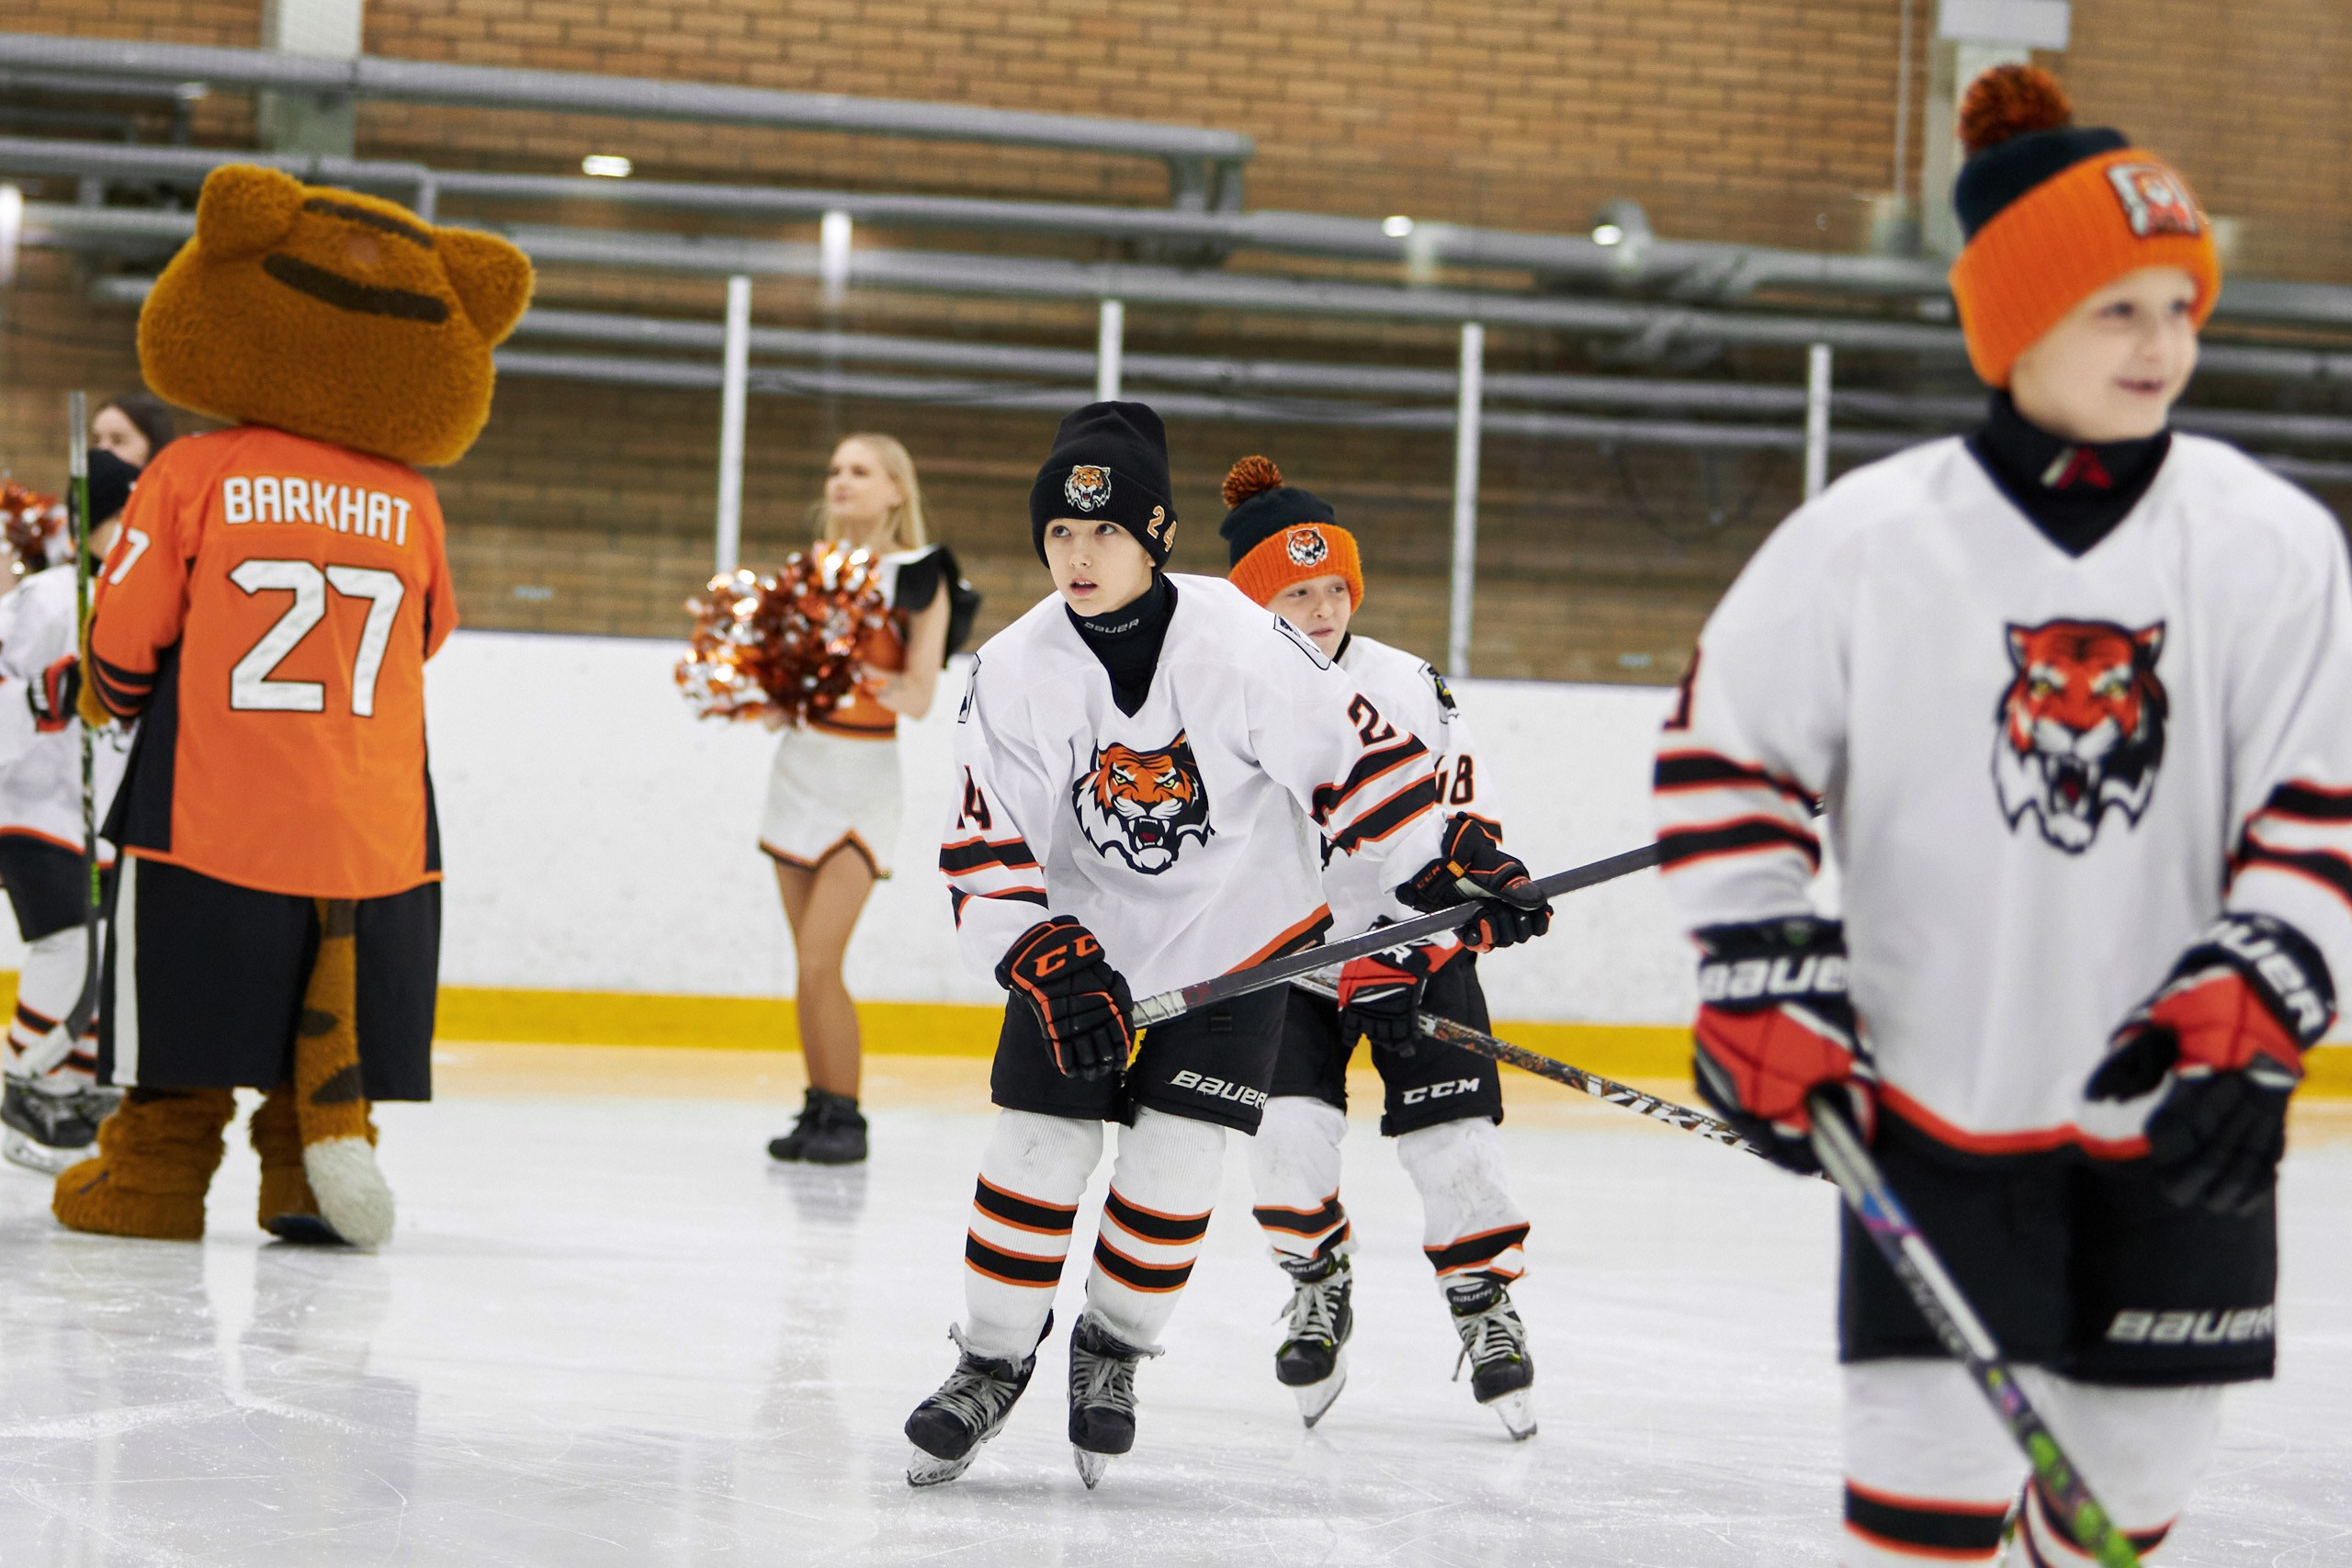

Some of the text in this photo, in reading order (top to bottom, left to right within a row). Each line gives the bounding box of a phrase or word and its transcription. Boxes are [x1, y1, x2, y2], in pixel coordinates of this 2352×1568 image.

[224, 476, 412, 546] BARKHAT
[1148, 505, 1177, 552] 24
[229, 559, 404, 717] 27
[956, 765, 991, 830] 4
[1034, 934, 1100, 977] CC
[1701, 955, 1848, 1001] BAUE
[1403, 1078, 1480, 1105] CCM
